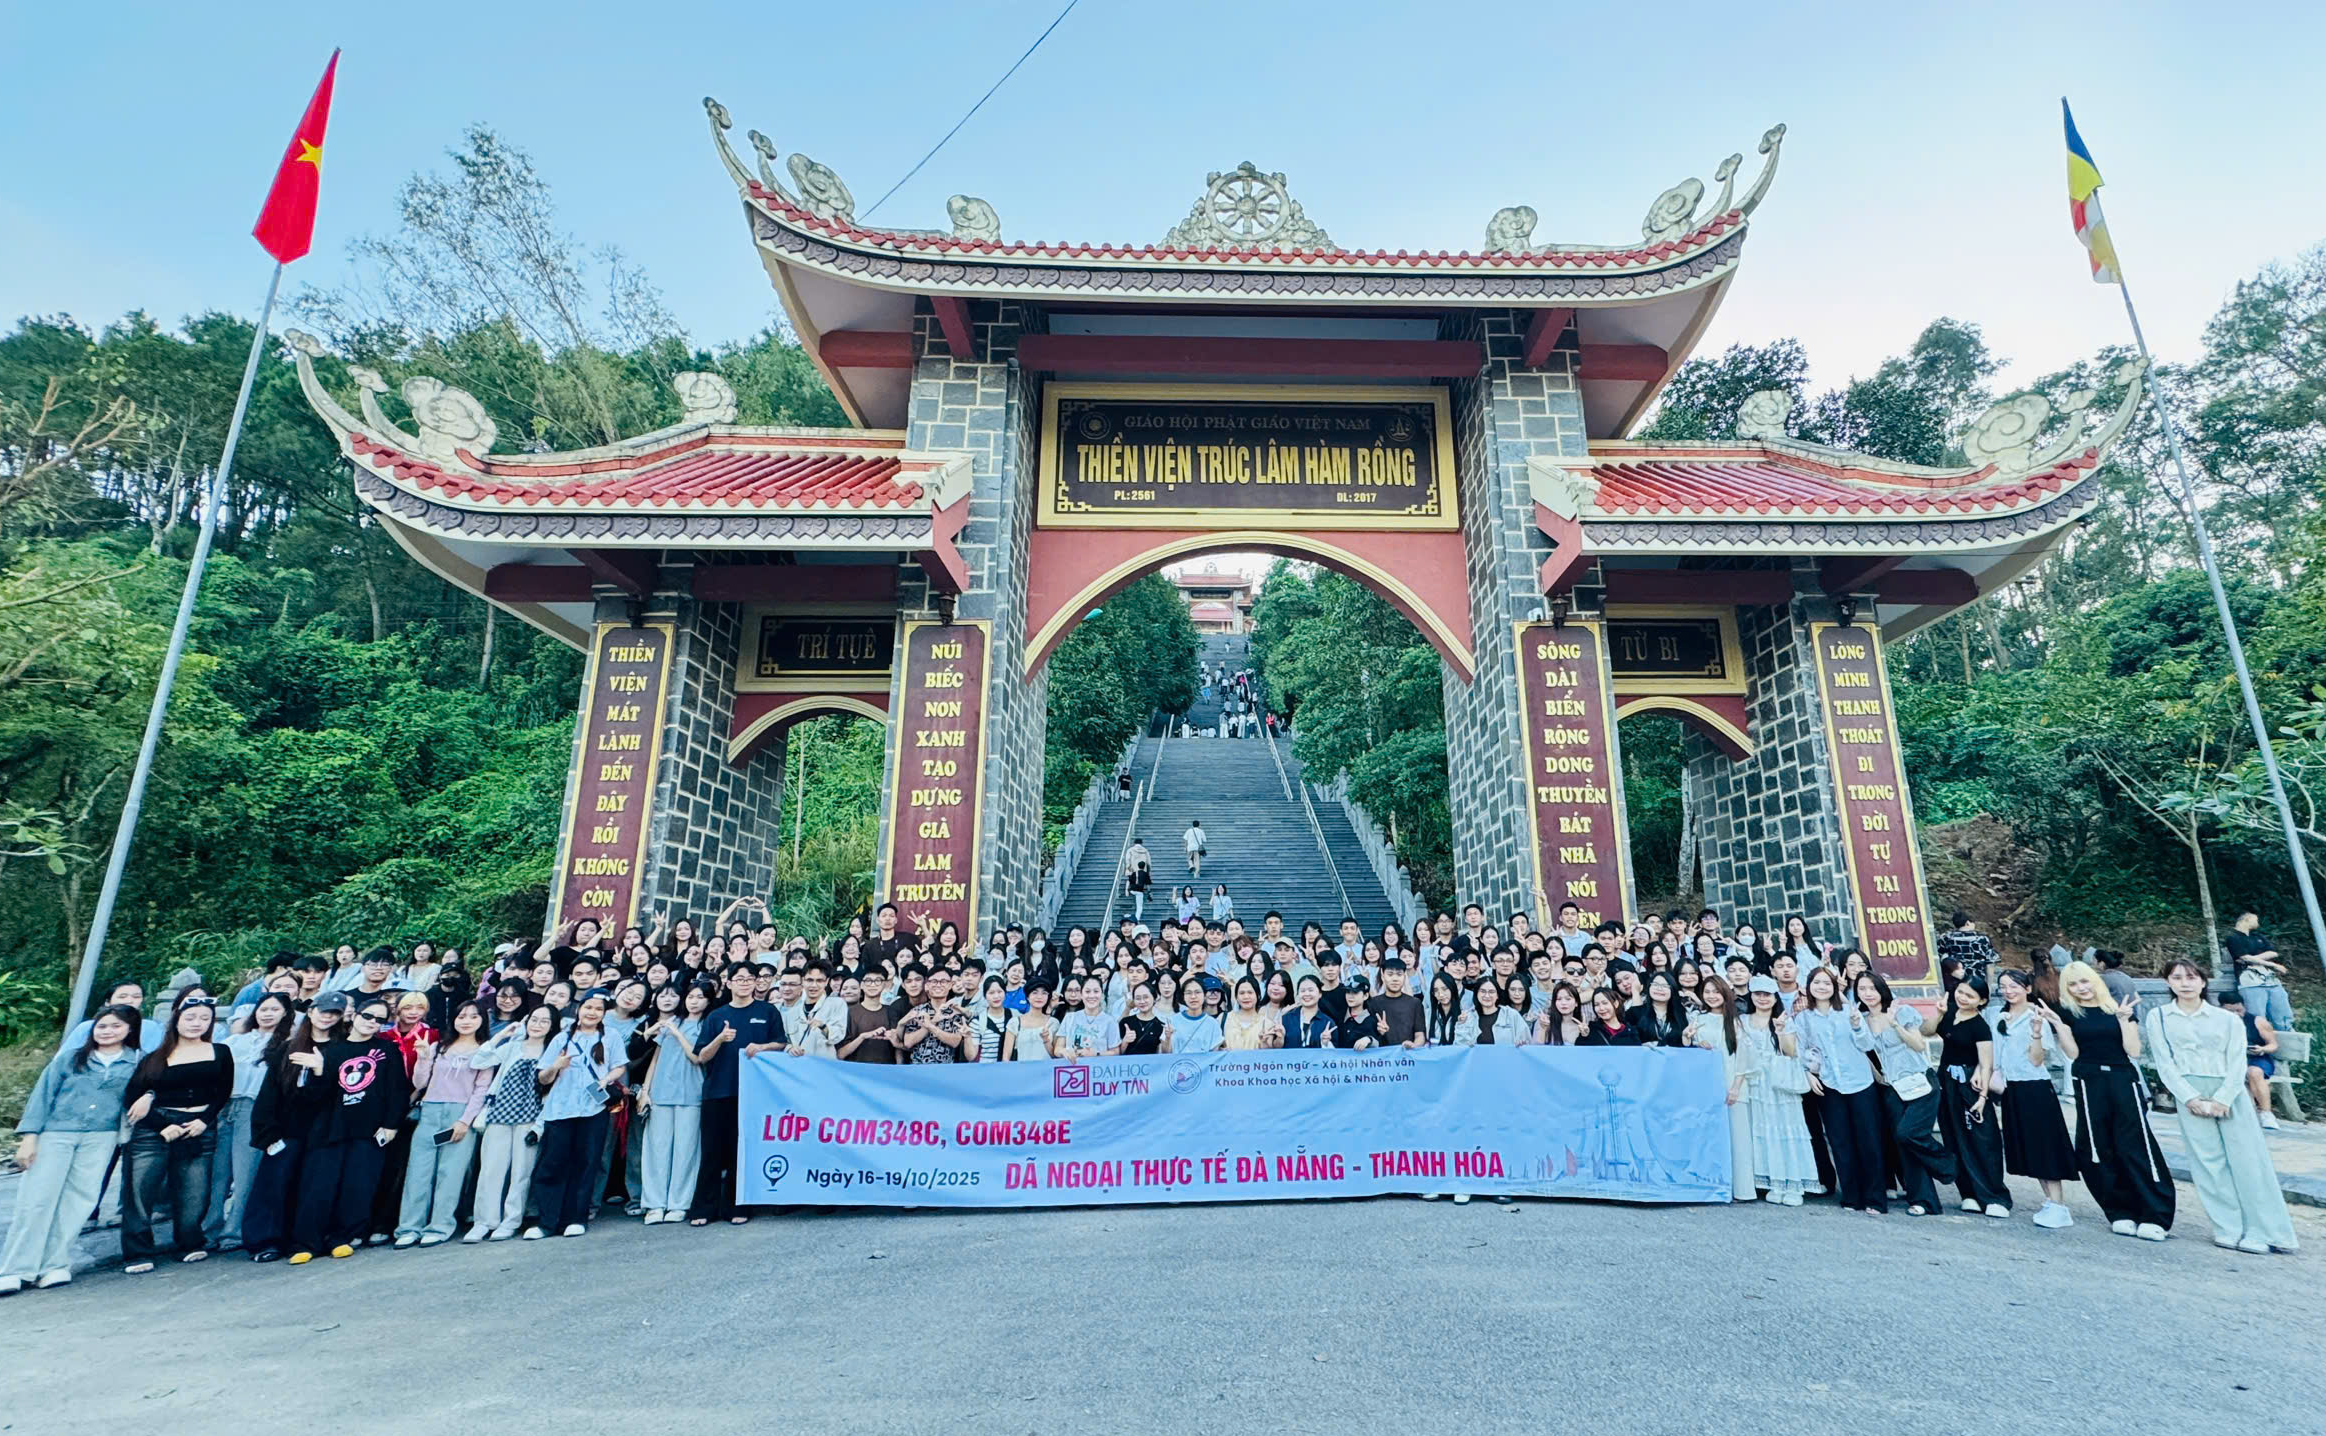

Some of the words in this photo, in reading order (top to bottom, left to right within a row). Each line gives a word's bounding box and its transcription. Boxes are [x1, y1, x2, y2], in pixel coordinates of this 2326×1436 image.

[1124, 413, 1163, 428] GIÁO
[1168, 413, 1198, 431] HỘI
[1204, 414, 1247, 431] PHẬT
[1251, 414, 1289, 429] GIÁO
[1295, 414, 1330, 431] VIỆT
[1335, 418, 1370, 430] NAM
[1077, 431, 1138, 483] THIỀN
[1143, 437, 1192, 491] VIỆN
[1197, 438, 1250, 484] TRÚC
[1255, 438, 1300, 484] LÂM
[1304, 439, 1351, 485] HÀM
[1357, 435, 1416, 487] RỒNG
[608, 638, 656, 663] THIỀN
[798, 626, 830, 659] TRÍ
[837, 627, 877, 664] TUỆ
[931, 639, 962, 660] NÚI
[1537, 640, 1581, 660] SÔNG
[1621, 630, 1647, 661] TỪ
[1658, 636, 1680, 661] BI
[1829, 640, 1865, 660] LÒNG
[609, 671, 648, 696] VIỆN
[925, 664, 964, 688] BIẾC
[1545, 667, 1578, 688] DÀI
[1833, 667, 1870, 688] MÌNH
[606, 700, 641, 722] MÁT
[924, 701, 962, 718] NON
[1545, 689, 1585, 716] BIỂN
[1833, 700, 1881, 716] THANH
[598, 729, 641, 751] LÀNH
[915, 730, 966, 747] XANH
[1544, 724, 1590, 749] RỘNG
[1839, 723, 1883, 744] THOÁT
[600, 756, 633, 781] ĐẾN
[922, 759, 957, 781] TẠO
[1545, 757, 1594, 773] DONG
[1857, 756, 1874, 773] ĐI
[596, 790, 629, 812] ĐÂY
[911, 787, 962, 811] DỰNG
[1538, 778, 1608, 804] THUYỀN
[1848, 784, 1895, 801] TRONG
[919, 816, 951, 839] GIÀ
[1559, 811, 1592, 833] BÁT
[1862, 810, 1890, 832] ĐỜI
[913, 853, 952, 871] LAM
[1559, 842, 1597, 864] NHÃ
[1870, 840, 1891, 865] TỰ
[573, 853, 630, 876] KHÔNG
[582, 884, 615, 908] CÒN
[896, 873, 967, 902] TRUYỀN
[1566, 872, 1598, 898] NỐI
[1873, 875, 1900, 897] TẠI
[1867, 906, 1917, 924] THONG
[1876, 939, 1918, 957] DONG
[1209, 1062, 1250, 1074] Trường
[1286, 1061, 1310, 1072] ngữ
[1340, 1059, 1358, 1071] hội
[1093, 1081, 1119, 1096] DUY
[1122, 1077, 1149, 1095] TÂN
[1215, 1078, 1245, 1087] Khoa
[1247, 1077, 1277, 1086] Khoa
[1280, 1076, 1301, 1087] học
[1322, 1074, 1340, 1086] hội
[1343, 1075, 1352, 1084] &
[762, 1109, 810, 1142] LỚP
[817, 1117, 946, 1149] COM348C,
[955, 1119, 1071, 1146] COM348E
[805, 1168, 854, 1188] Ngày
[858, 1168, 981, 1190] 16-19/10/2025
[1005, 1156, 1038, 1190] DÃ
[1046, 1160, 1122, 1194] NGOẠI
[1130, 1156, 1193, 1192] THỰC
[1201, 1148, 1230, 1185] TẾ
[1235, 1149, 1269, 1184] ĐÀ
[1276, 1145, 1345, 1182] NẴNG
[1368, 1150, 1446, 1179] THANH
[1454, 1145, 1505, 1179] HÓA
